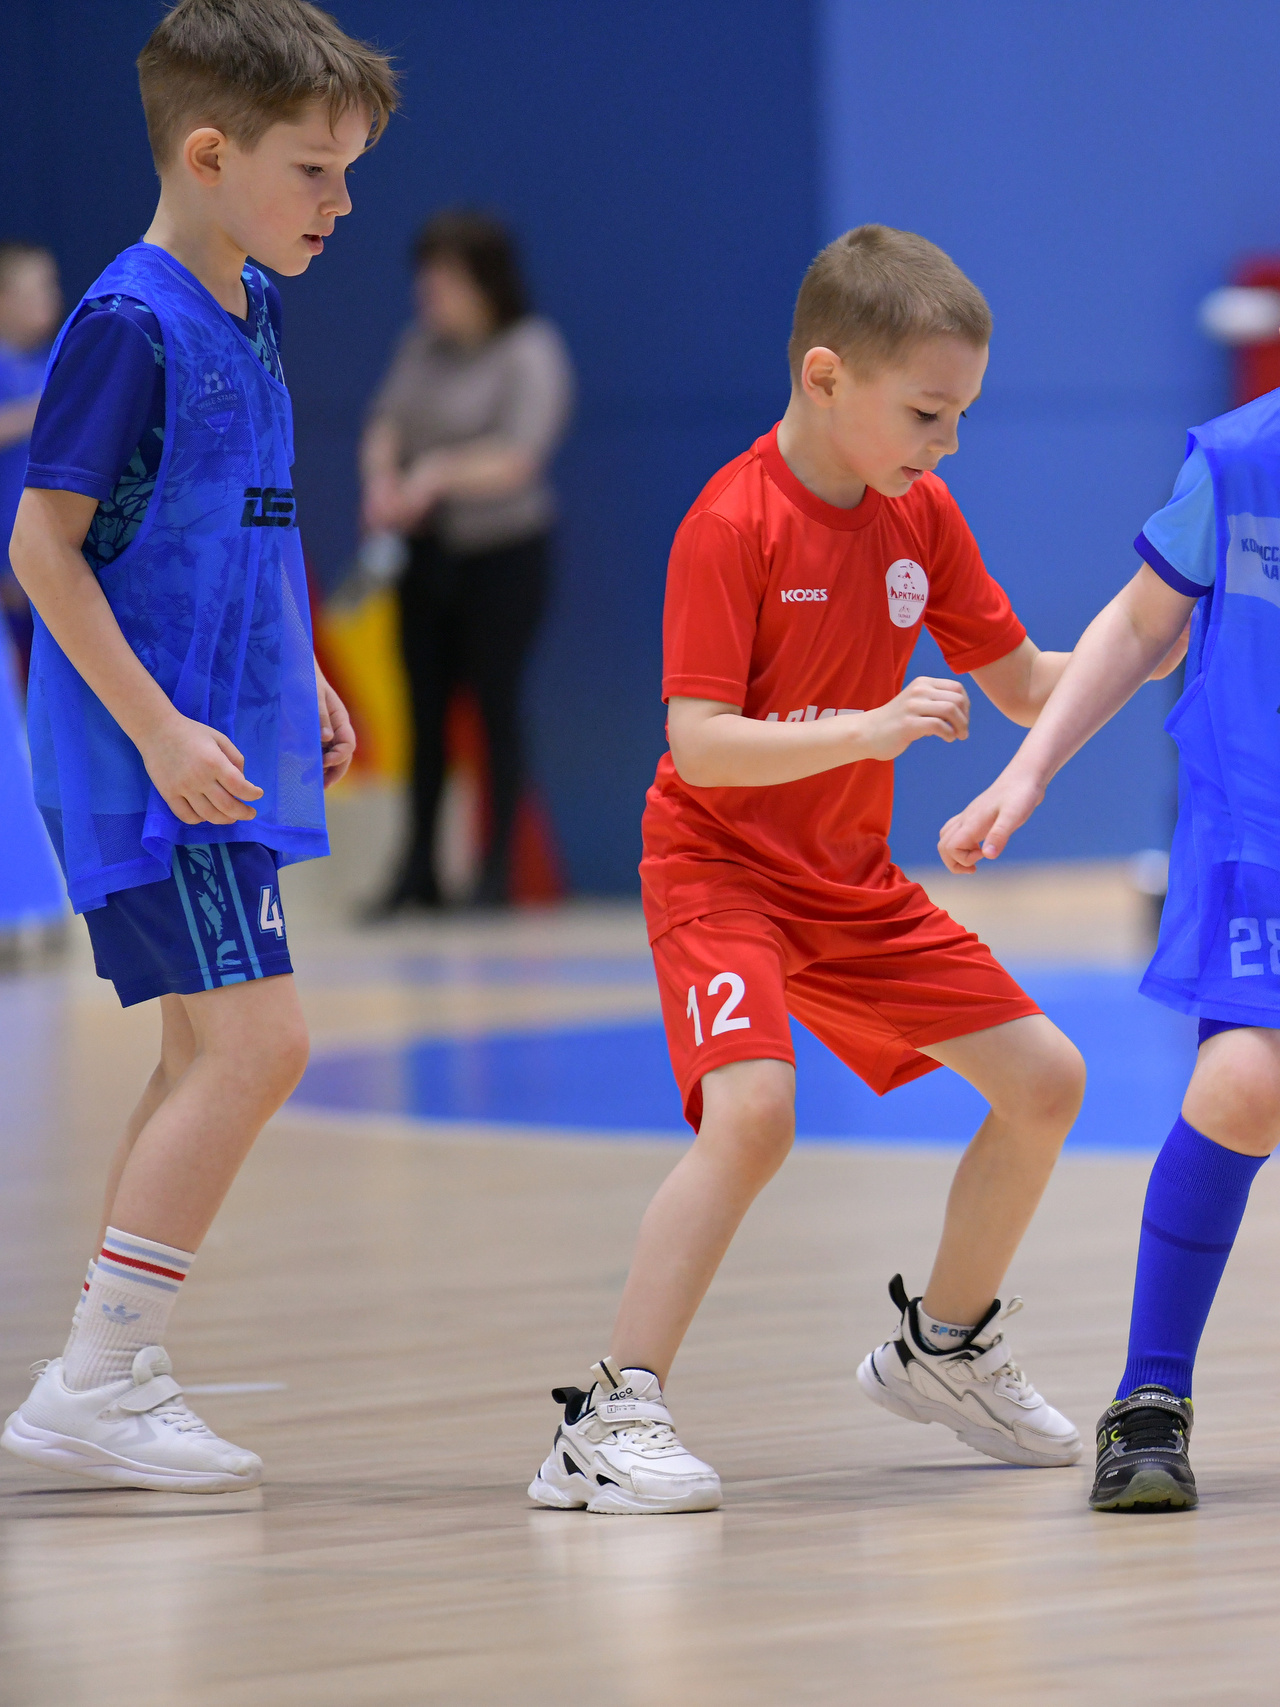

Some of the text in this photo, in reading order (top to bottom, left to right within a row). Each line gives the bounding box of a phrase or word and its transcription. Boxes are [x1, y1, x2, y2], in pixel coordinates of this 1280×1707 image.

[781, 588, 829, 603] KODES
[258, 885, 285, 940] 4
[686, 971, 752, 1047] 12
[930, 1324, 973, 1338] SPOR
[1139, 1394, 1182, 1407] GEOX
